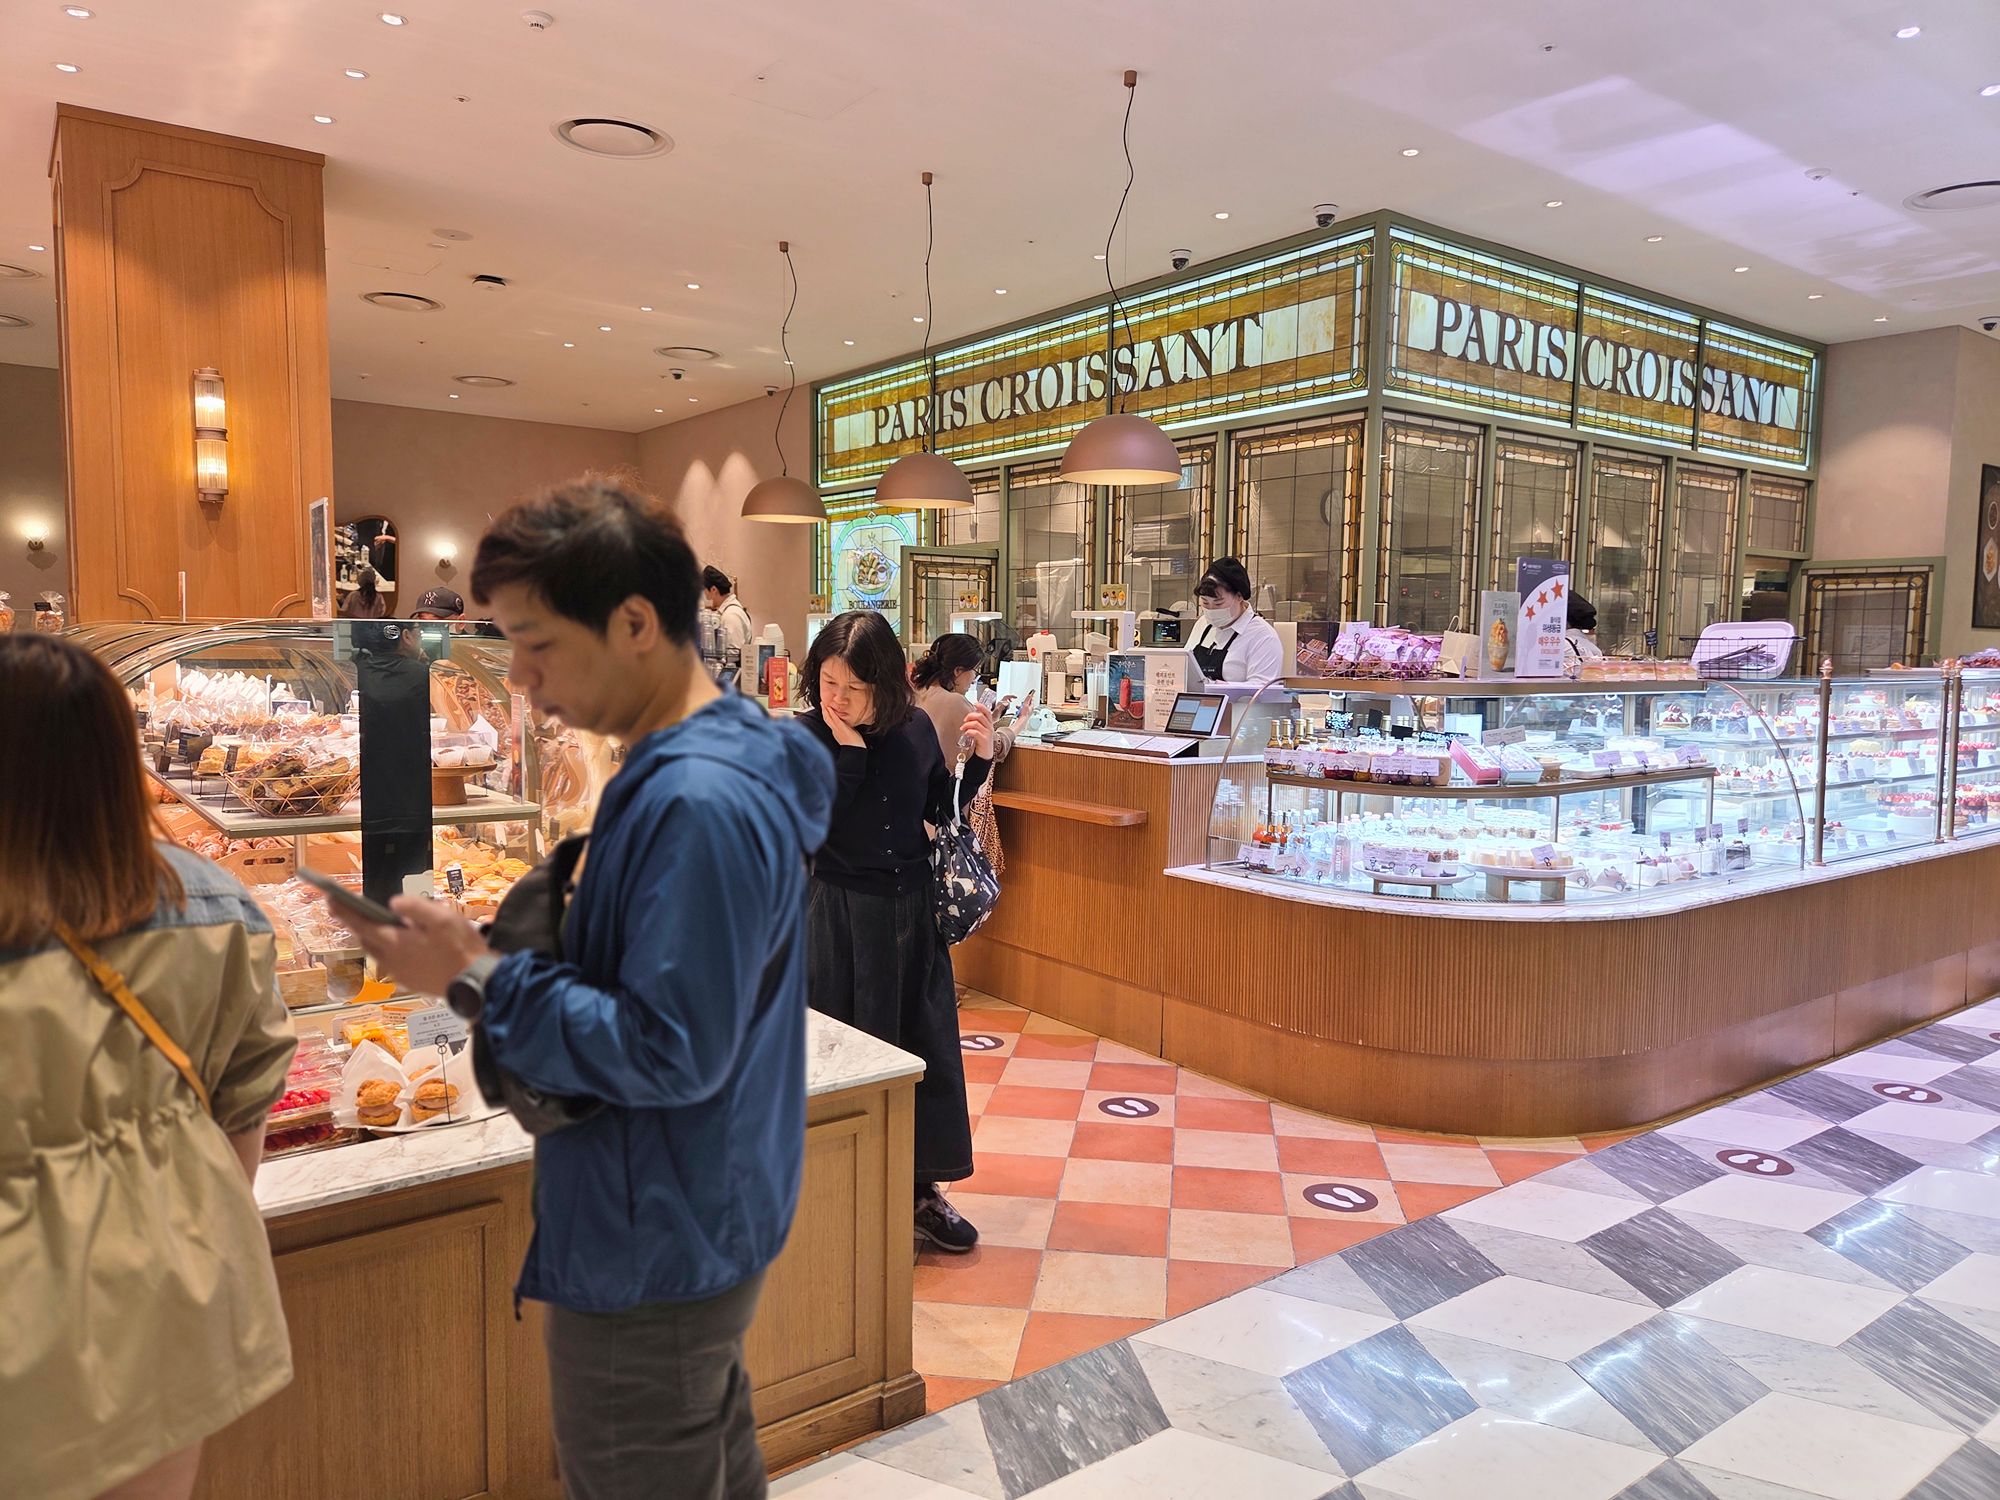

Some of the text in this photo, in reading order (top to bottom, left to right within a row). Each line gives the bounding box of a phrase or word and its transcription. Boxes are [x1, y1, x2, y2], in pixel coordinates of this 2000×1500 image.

[872, 312, 1263, 447] PARIS CROISSANT
[1430, 298, 1785, 428] PARIS CROISSANT
[848, 600, 897, 609] BOULANGERIE
